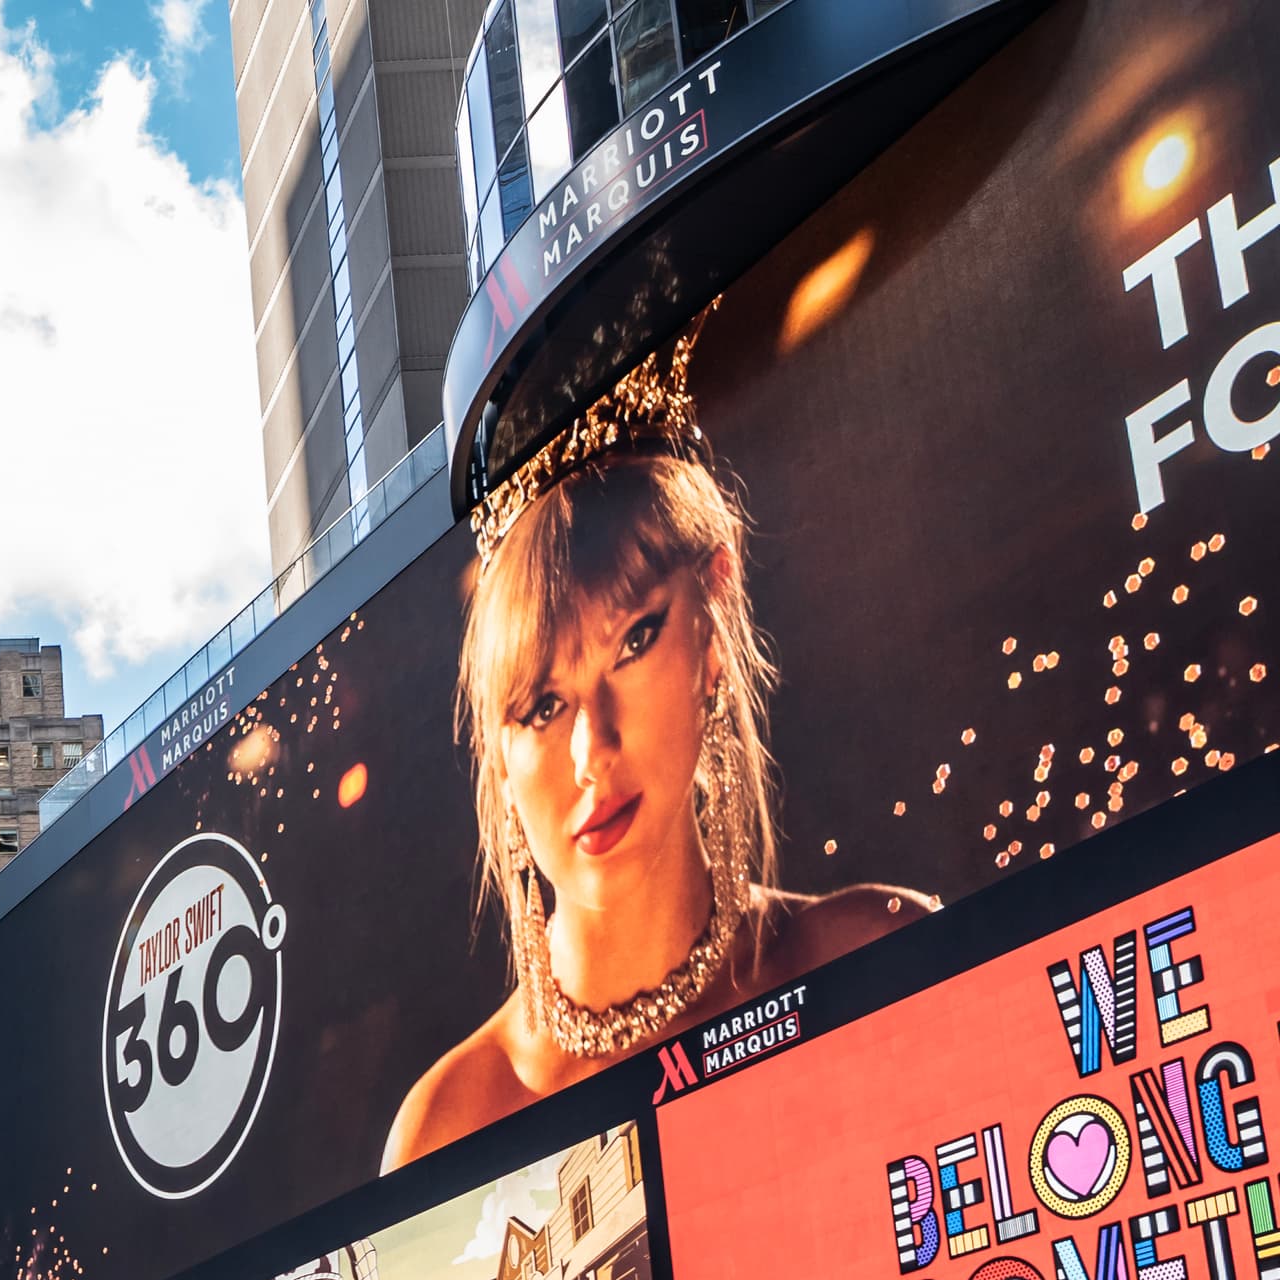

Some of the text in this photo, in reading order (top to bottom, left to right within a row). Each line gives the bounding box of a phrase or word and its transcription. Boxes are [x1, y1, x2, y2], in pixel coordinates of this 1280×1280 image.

[538, 60, 721, 239] MARRIOTT
[543, 123, 700, 277] MARQUIS
[161, 667, 236, 745] MARRIOTT
[162, 701, 228, 770] MARQUIS
[139, 883, 225, 987] TAYLOR SWIFT
[703, 985, 807, 1050] MARRIOTT
[1047, 905, 1209, 1078] WE
[704, 1016, 799, 1076] MARQUIS
